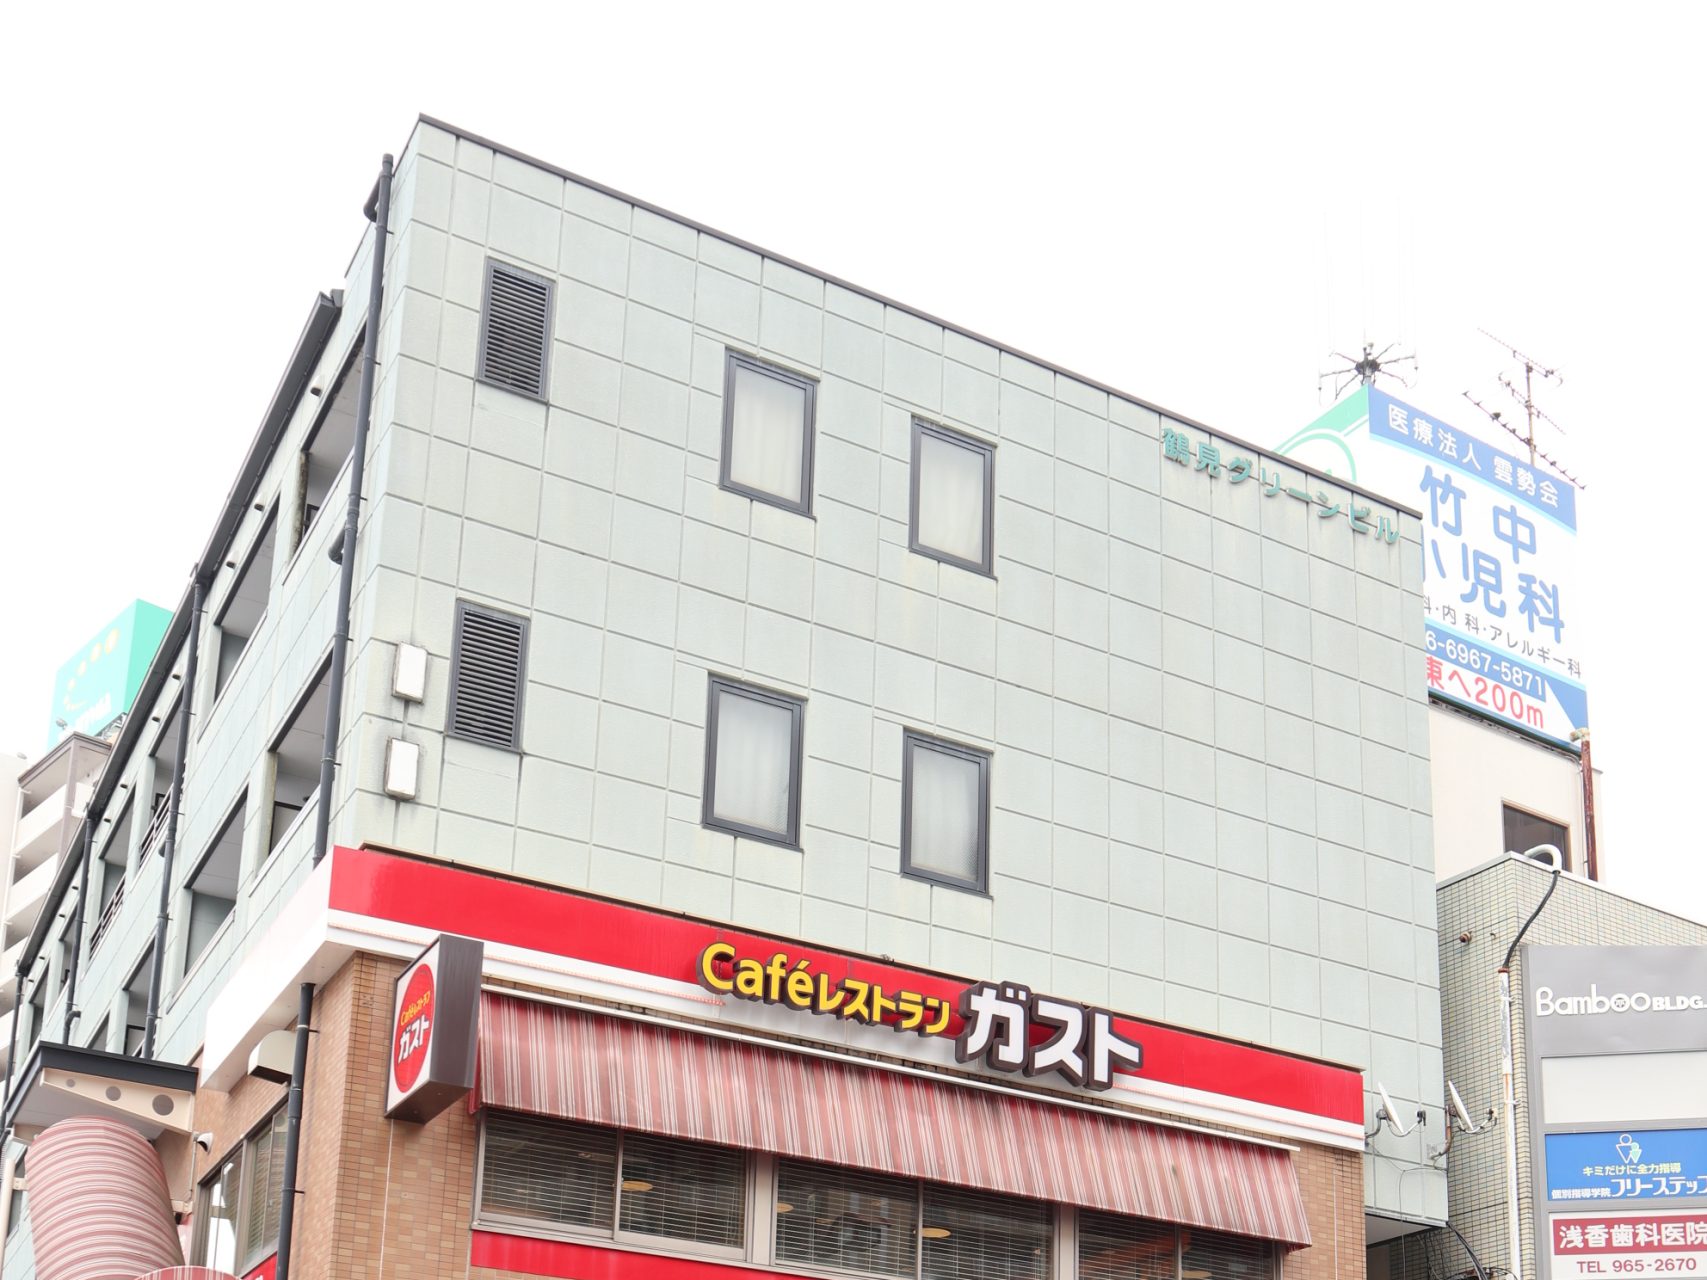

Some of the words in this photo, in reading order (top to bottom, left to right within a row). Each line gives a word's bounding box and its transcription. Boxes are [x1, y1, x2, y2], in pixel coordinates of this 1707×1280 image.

[1162, 427, 1400, 545] 鶴見グリーンビル
[1388, 403, 1482, 472] 医療法人
[1494, 455, 1559, 508] 雲勢会
[1419, 464, 1537, 565] 竹中
[700, 941, 816, 1001] Café
[817, 972, 951, 1034] レストラン
[960, 981, 1142, 1087] ガスト
[398, 1014, 430, 1064] ガスト
[1559, 1221, 1707, 1249] 浅香歯科医院
[1576, 1260, 1607, 1273] TEL
[1612, 1258, 1697, 1273] 965-2670
